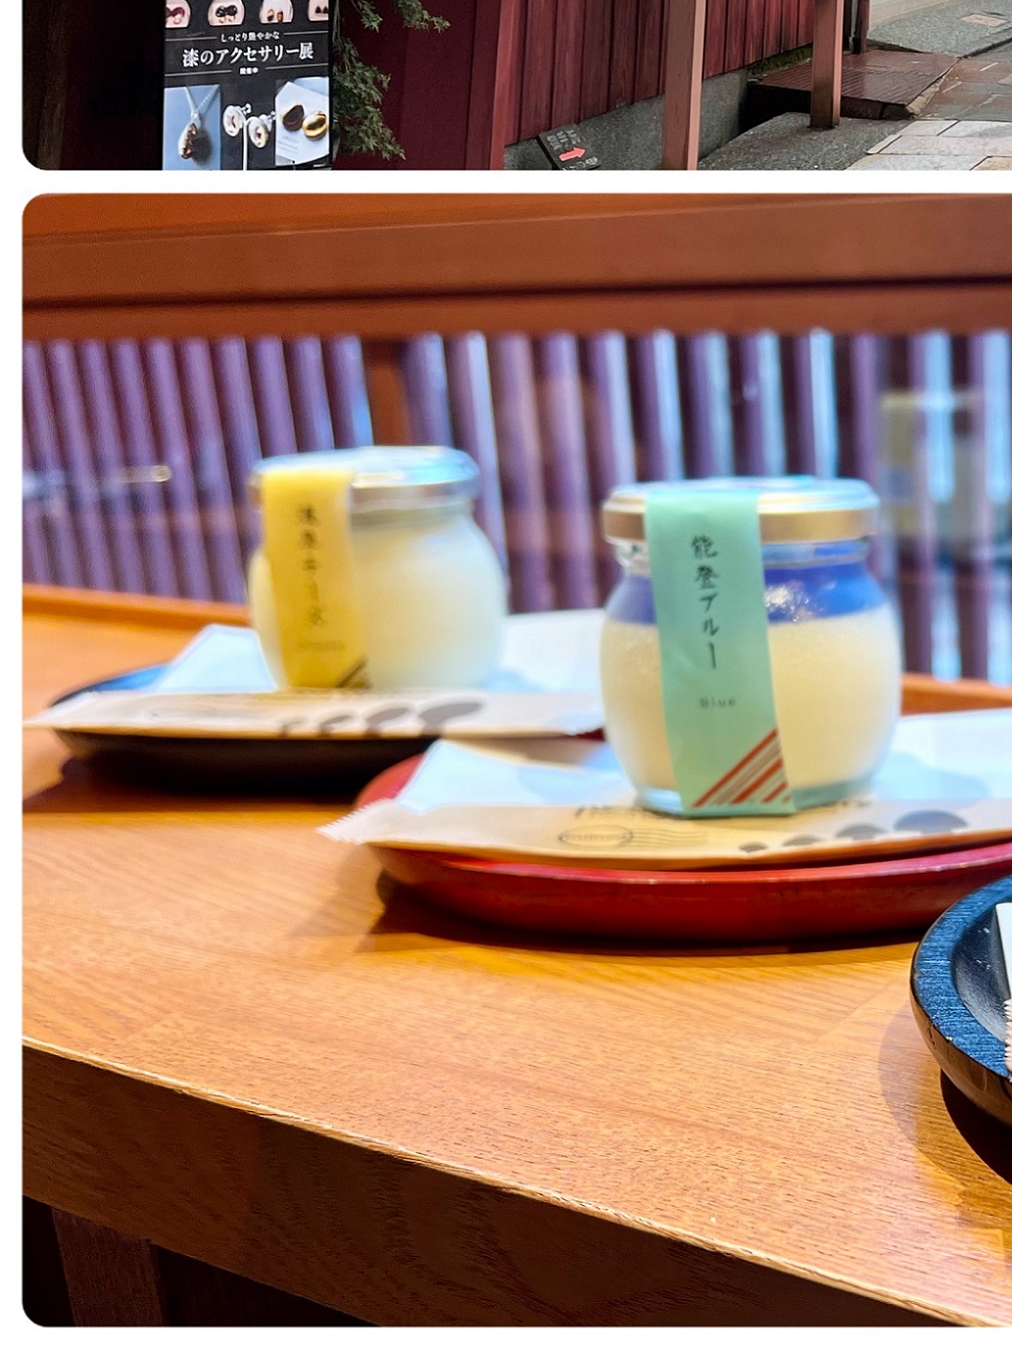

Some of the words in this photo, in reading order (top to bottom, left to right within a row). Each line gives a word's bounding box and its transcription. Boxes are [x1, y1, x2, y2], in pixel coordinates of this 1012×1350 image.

[182, 42, 314, 67] 漆のアクセサリー展
[700, 697, 736, 710] Blue
